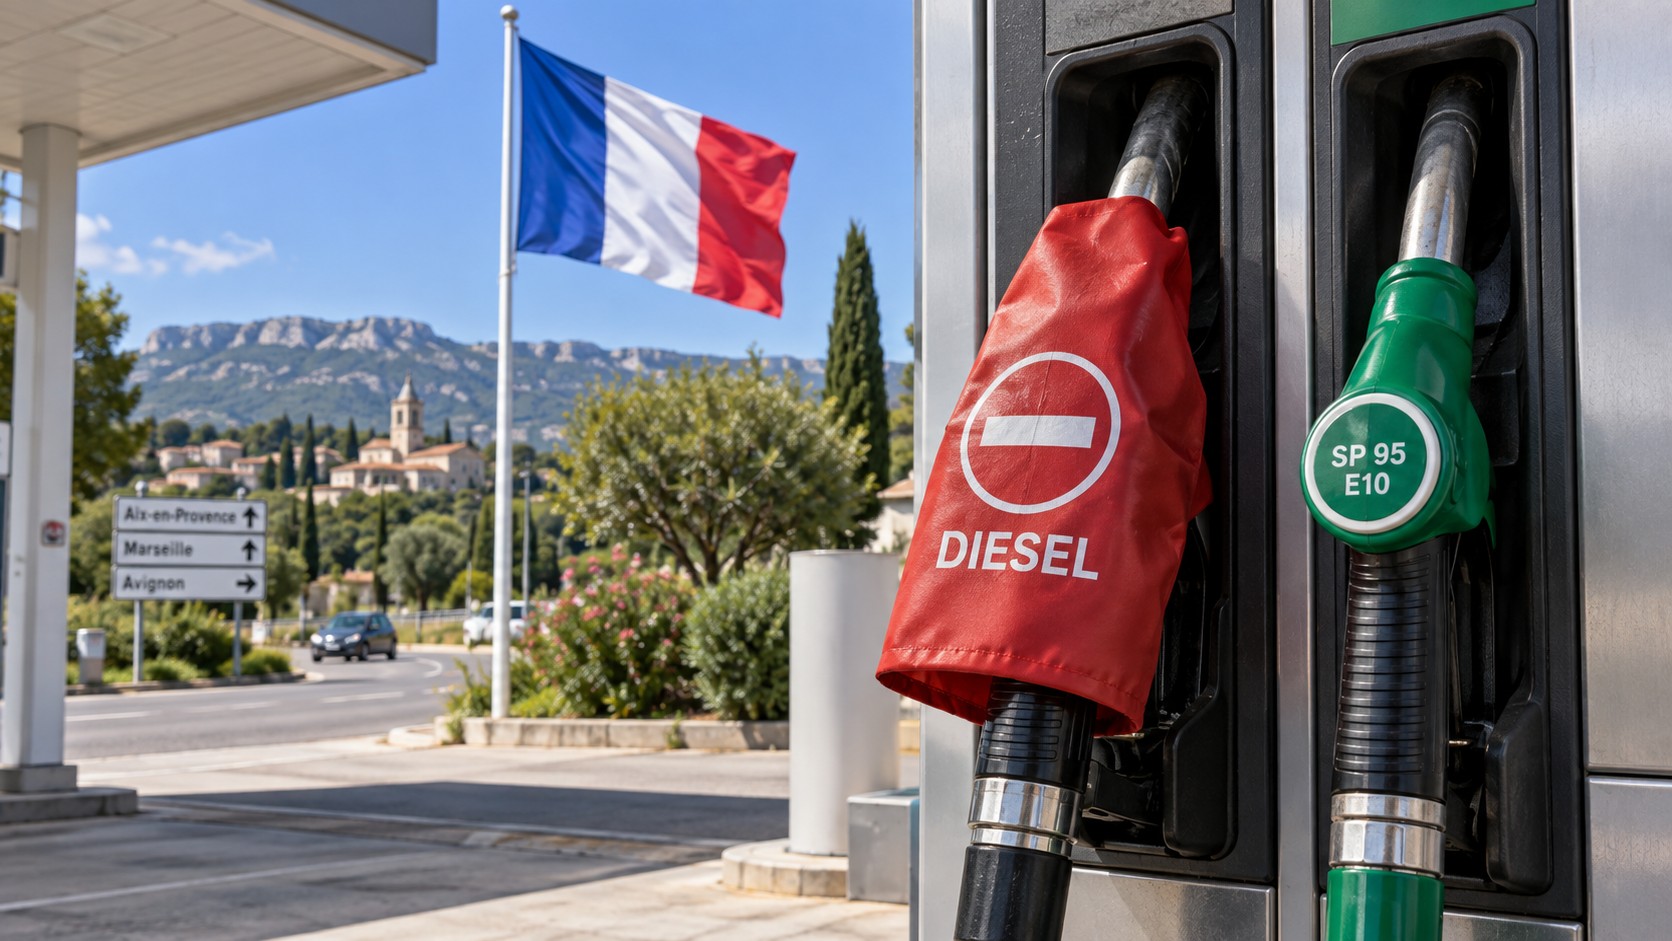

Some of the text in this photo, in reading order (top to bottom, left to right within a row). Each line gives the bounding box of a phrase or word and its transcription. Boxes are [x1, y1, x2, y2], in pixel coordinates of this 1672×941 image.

[1331, 442, 1406, 468] SP 95
[1345, 472, 1390, 496] E10
[123, 541, 193, 557] Marseille
[936, 530, 1099, 580] DIESEL
[122, 575, 185, 593] Avignon
